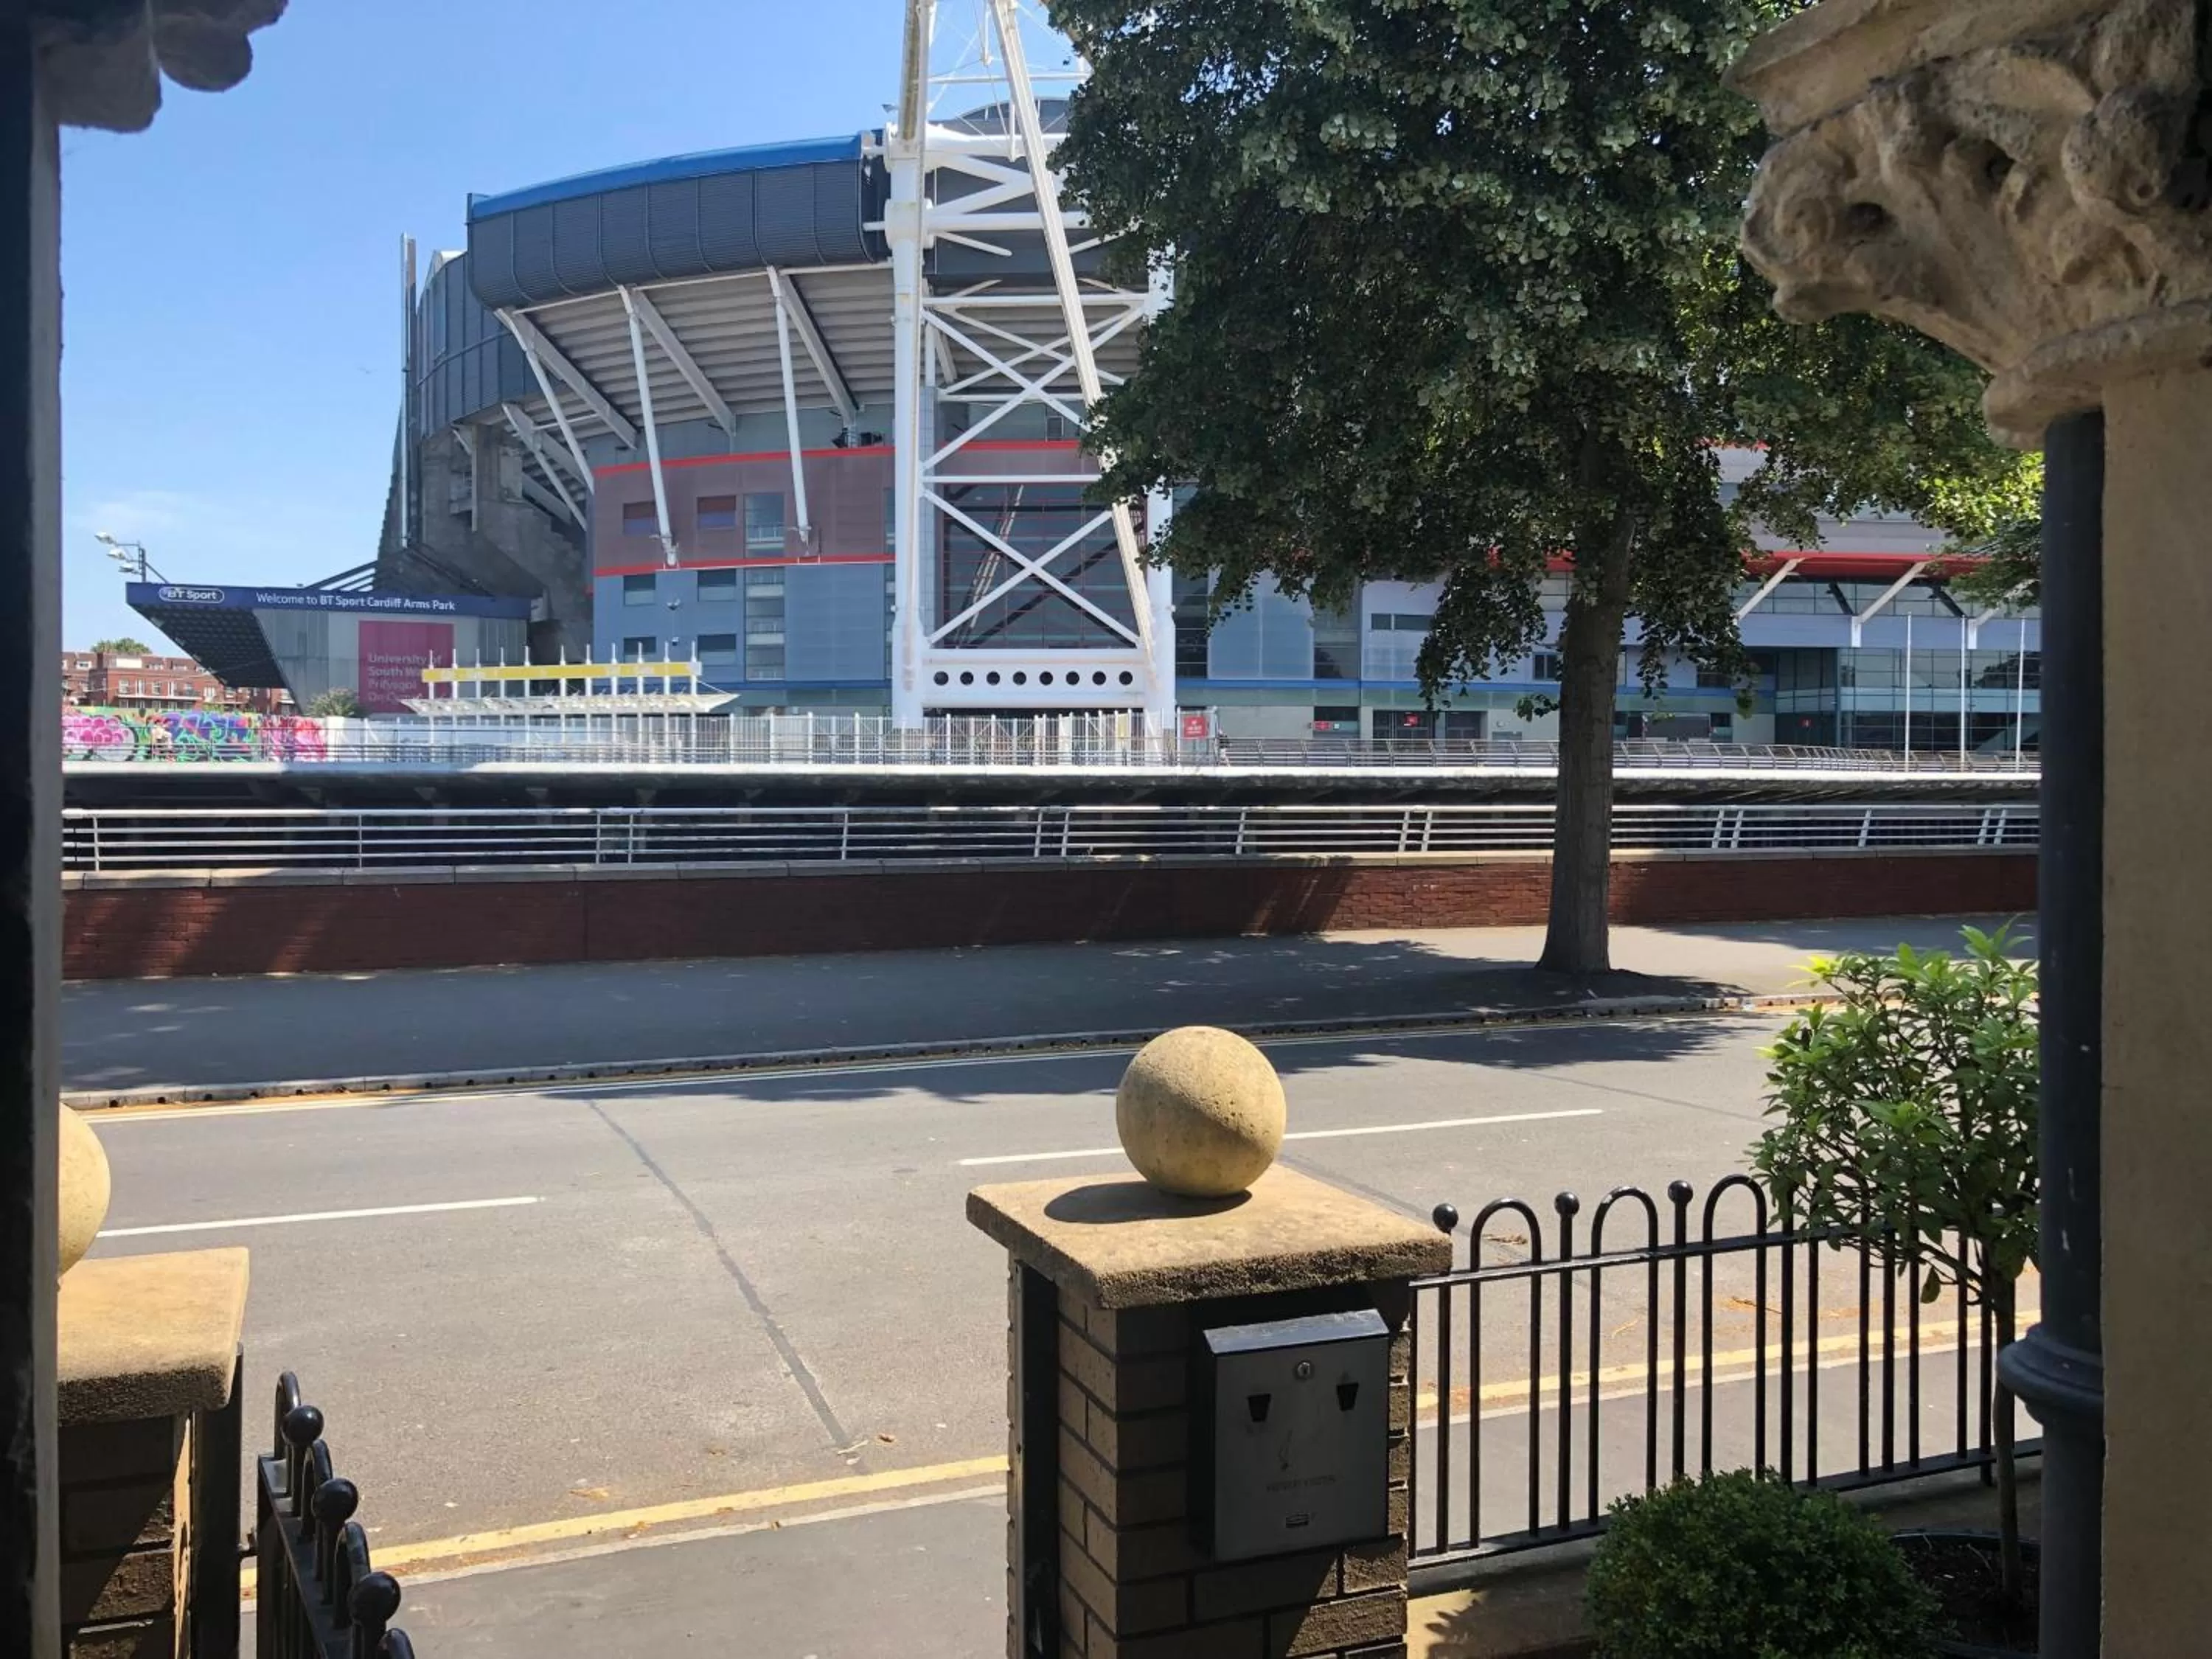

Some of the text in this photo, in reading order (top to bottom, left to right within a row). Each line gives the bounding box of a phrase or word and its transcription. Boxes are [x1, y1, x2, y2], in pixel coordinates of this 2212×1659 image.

[167, 588, 217, 600] BT Sport
[256, 592, 456, 610] Welcome to BT Sport Cardiff Arms Park
[368, 653, 426, 665] University
[368, 666, 403, 676] South
